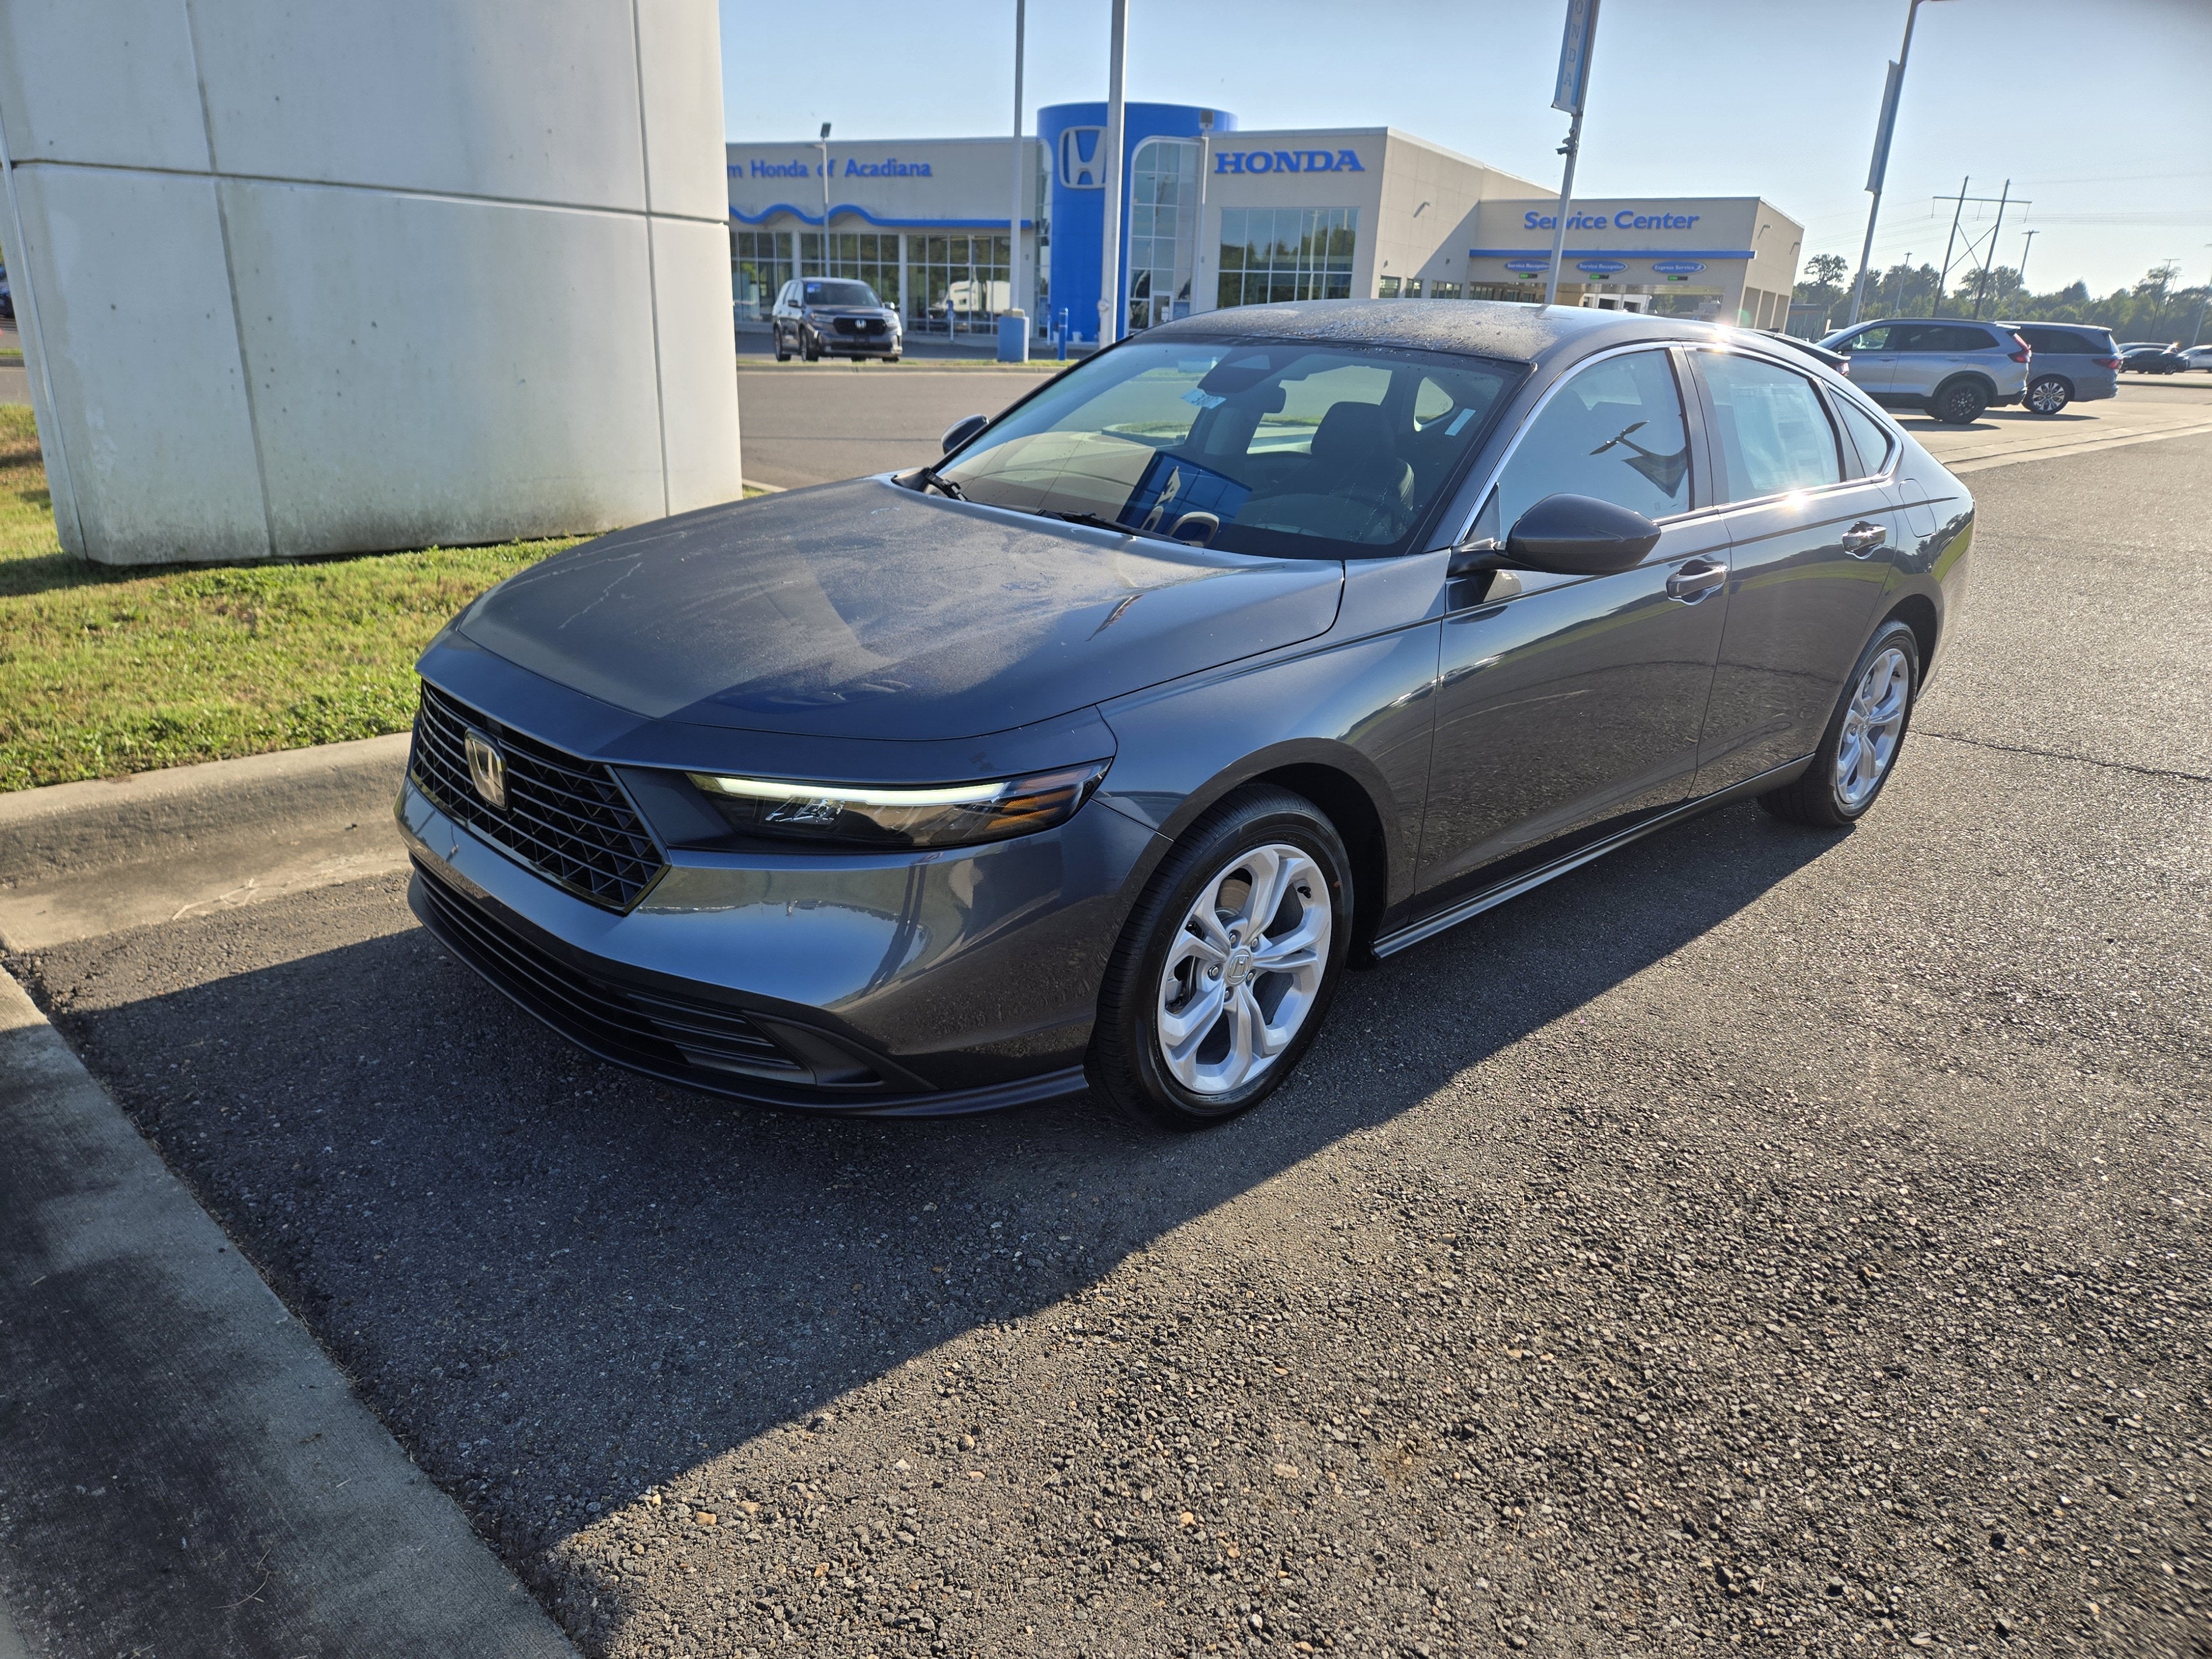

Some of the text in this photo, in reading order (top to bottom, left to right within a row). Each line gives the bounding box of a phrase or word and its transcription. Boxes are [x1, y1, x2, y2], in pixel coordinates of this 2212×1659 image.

[750, 159, 809, 178] Honda
[817, 158, 836, 178] of
[844, 158, 932, 178] Acadiana
[1214, 149, 1365, 174] HONDA
[1614, 210, 1700, 229] Center
